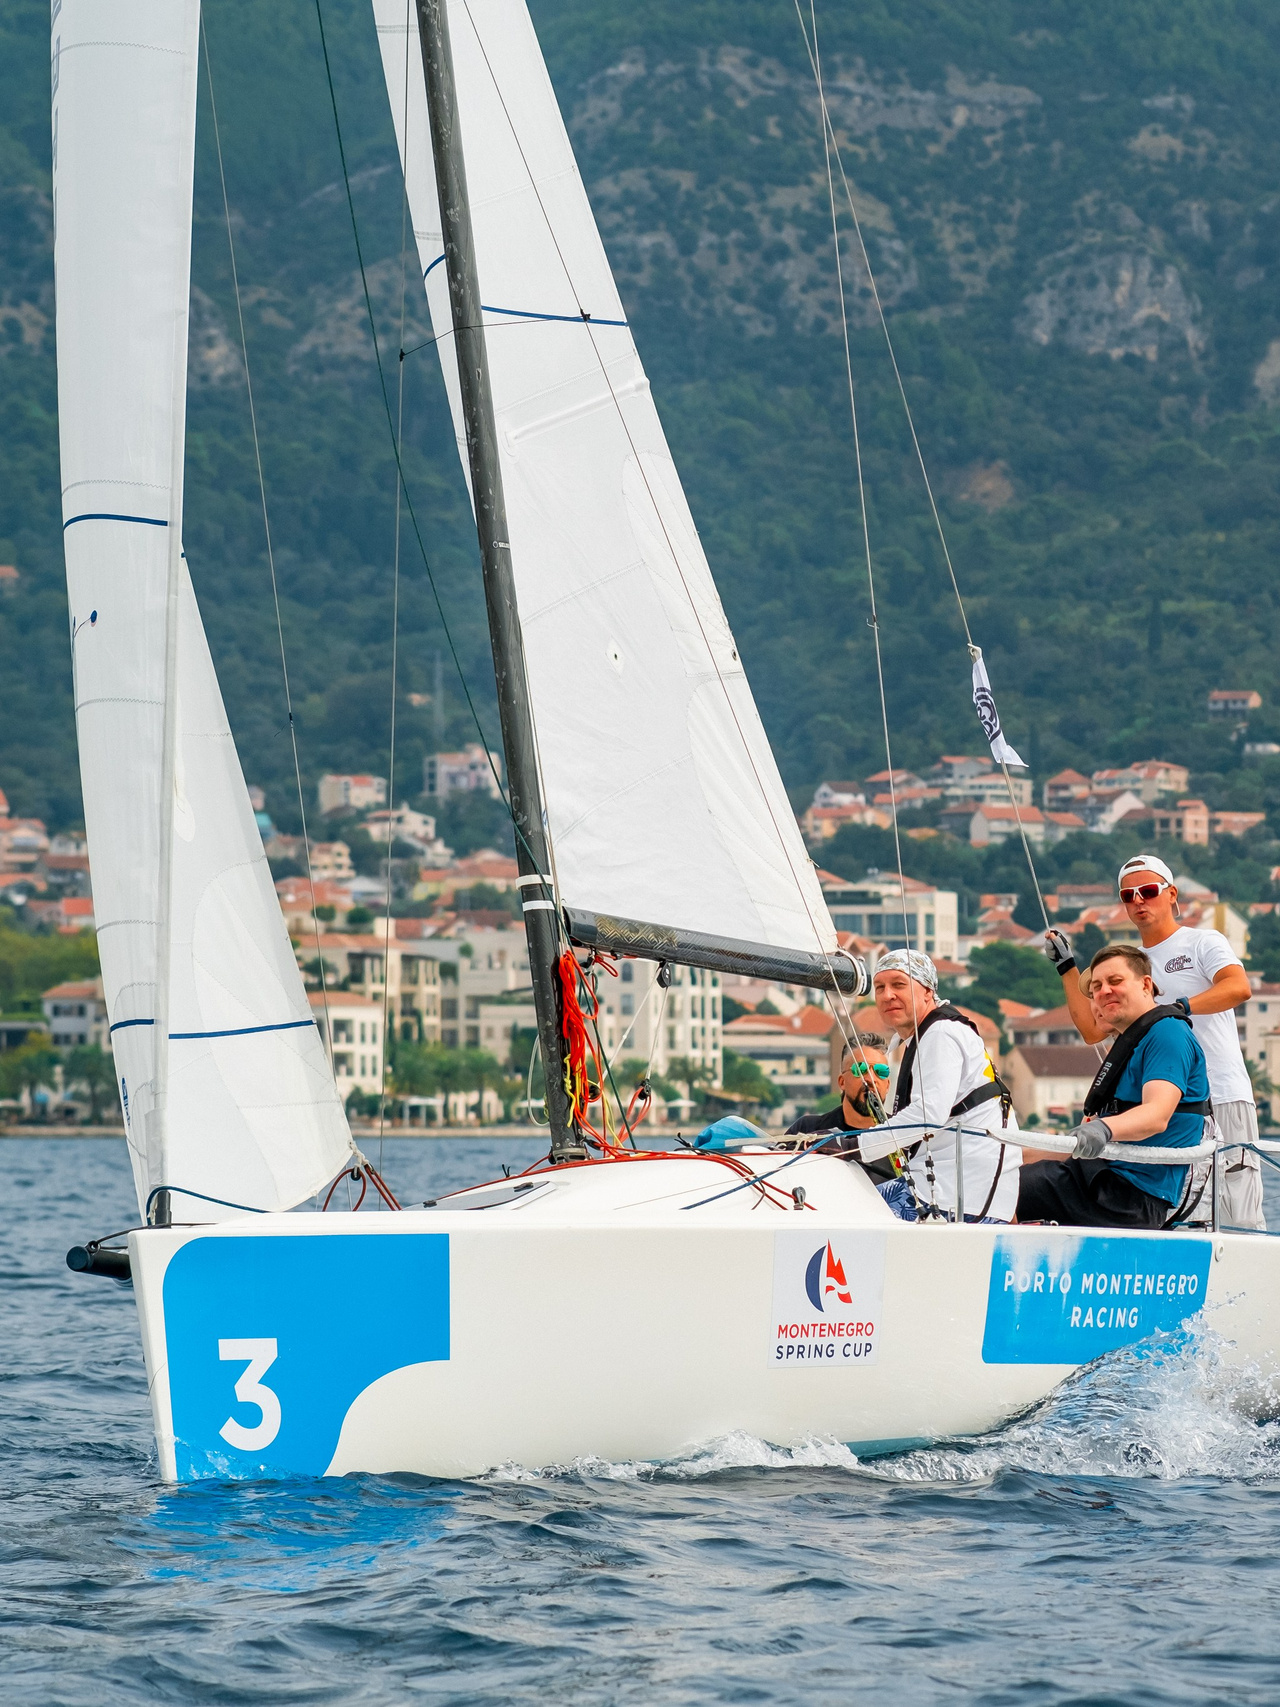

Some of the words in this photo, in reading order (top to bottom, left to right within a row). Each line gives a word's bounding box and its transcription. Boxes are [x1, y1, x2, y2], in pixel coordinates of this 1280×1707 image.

[1003, 1270, 1072, 1294] PORTO
[1080, 1272, 1199, 1296] MONTENEGRO
[1070, 1306, 1139, 1329] RACING
[777, 1321, 875, 1340] MONTENEGRO
[775, 1343, 835, 1361] SPRING
[842, 1342, 873, 1358] CUP
[218, 1337, 282, 1452] 3
